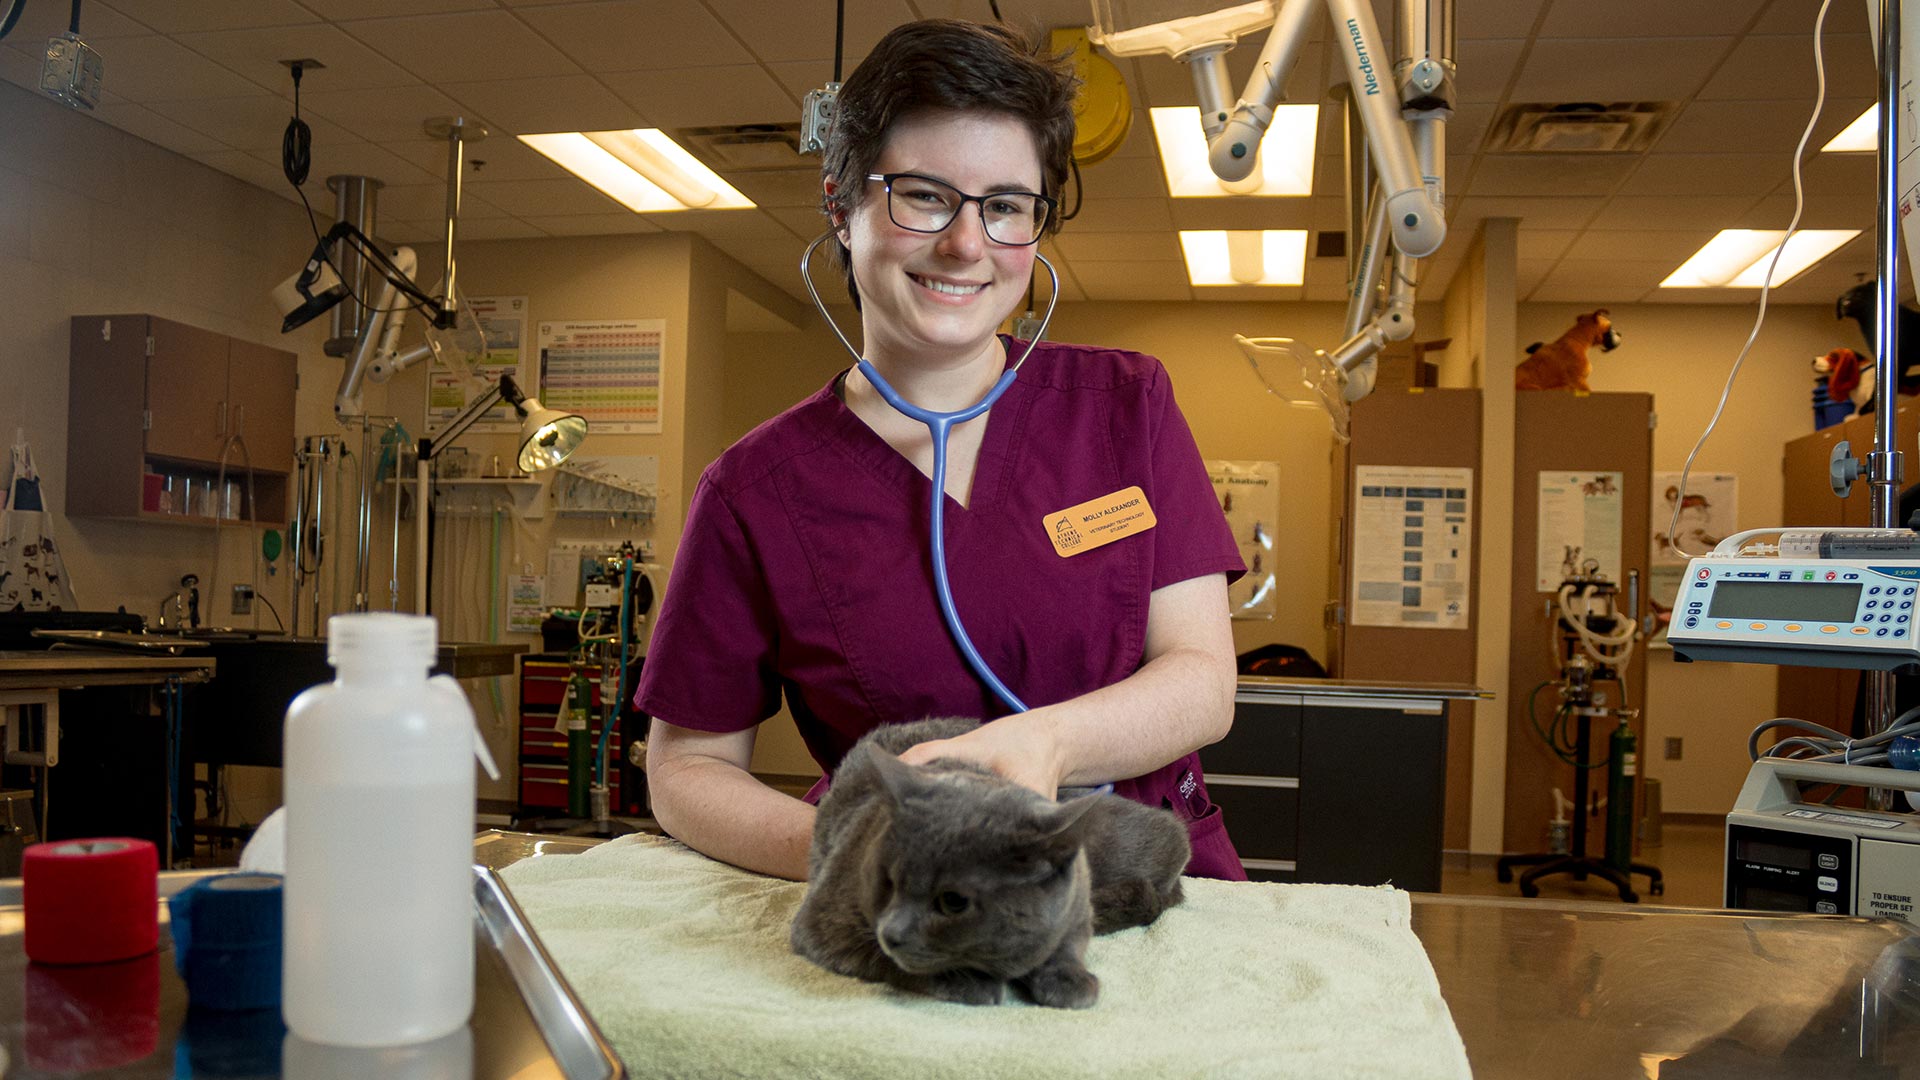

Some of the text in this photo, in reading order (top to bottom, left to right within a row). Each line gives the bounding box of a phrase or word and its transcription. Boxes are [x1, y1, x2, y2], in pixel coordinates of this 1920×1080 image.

[1347, 18, 1380, 95] Nederman
[1354, 244, 1371, 297] Nederman
[1228, 476, 1269, 488] Anatomy
[1082, 498, 1141, 523] MOLLY ALEXANDER
[1088, 511, 1145, 534] VETERINARY TECHNOLOGY
[1109, 522, 1130, 533] STUDENT
[1055, 533, 1083, 545] TECHNICAL
[1057, 529, 1078, 539] ATHENS
[1061, 538, 1082, 549] COLLEGE
[1763, 866, 1782, 874] PUMPING
[1872, 892, 1912, 904] TO ENSURE
[1870, 900, 1913, 912] PROPER SET
